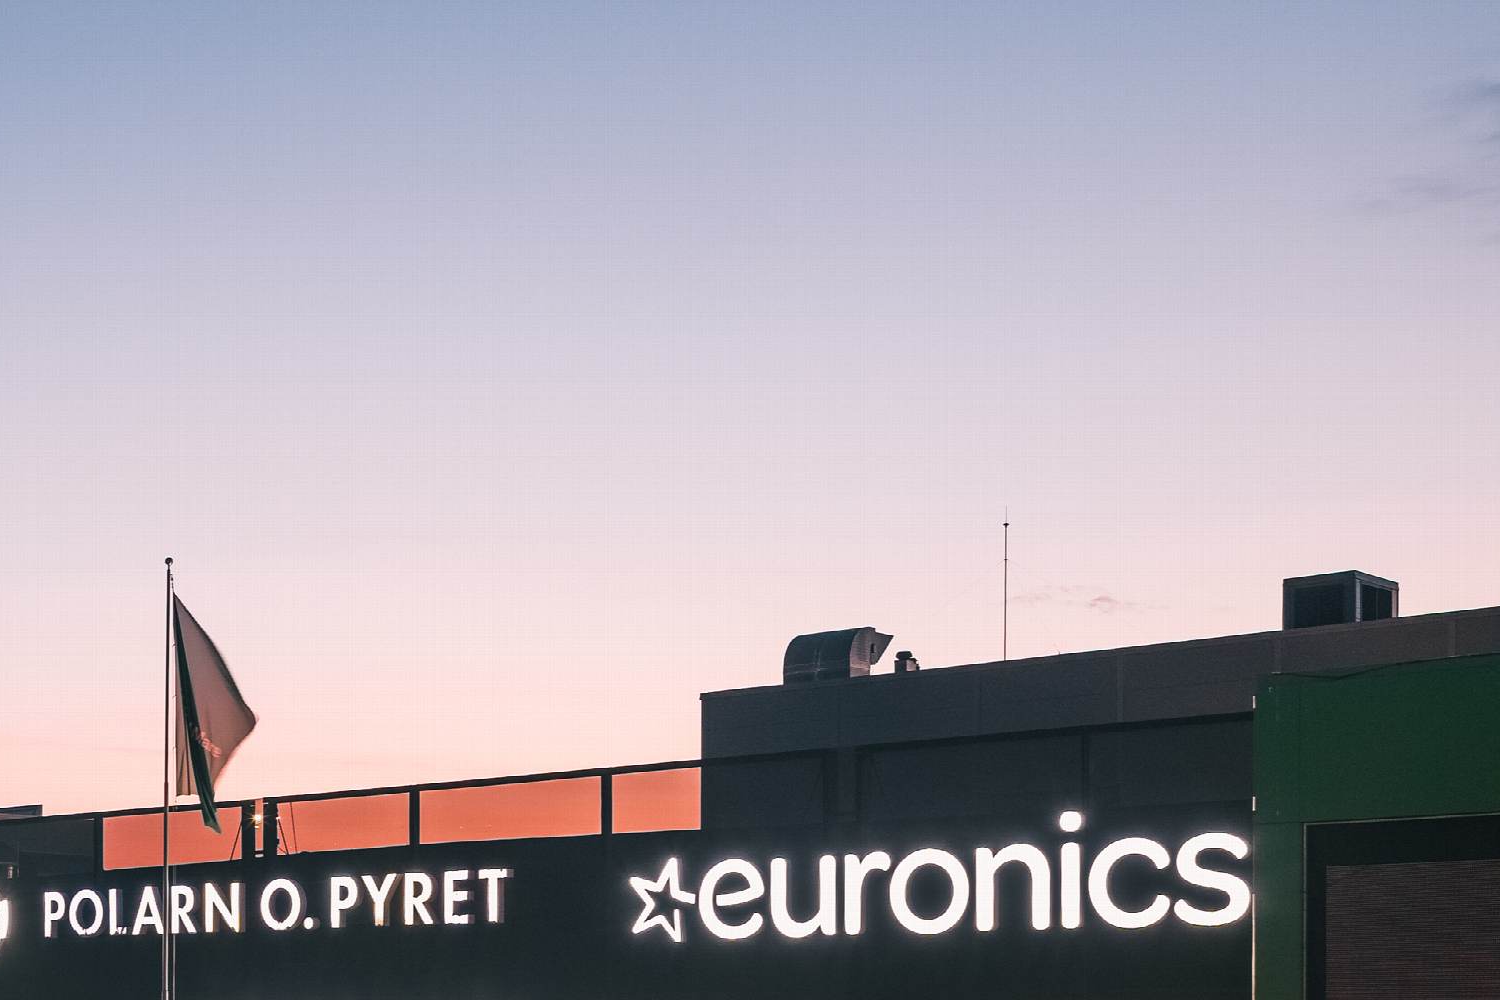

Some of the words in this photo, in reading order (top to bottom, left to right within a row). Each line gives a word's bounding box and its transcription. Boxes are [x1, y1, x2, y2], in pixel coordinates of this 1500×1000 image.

[43, 880, 240, 938] POLARN
[260, 878, 314, 931] O.
[331, 868, 508, 928] PYRET
[699, 810, 1252, 940] euronics
